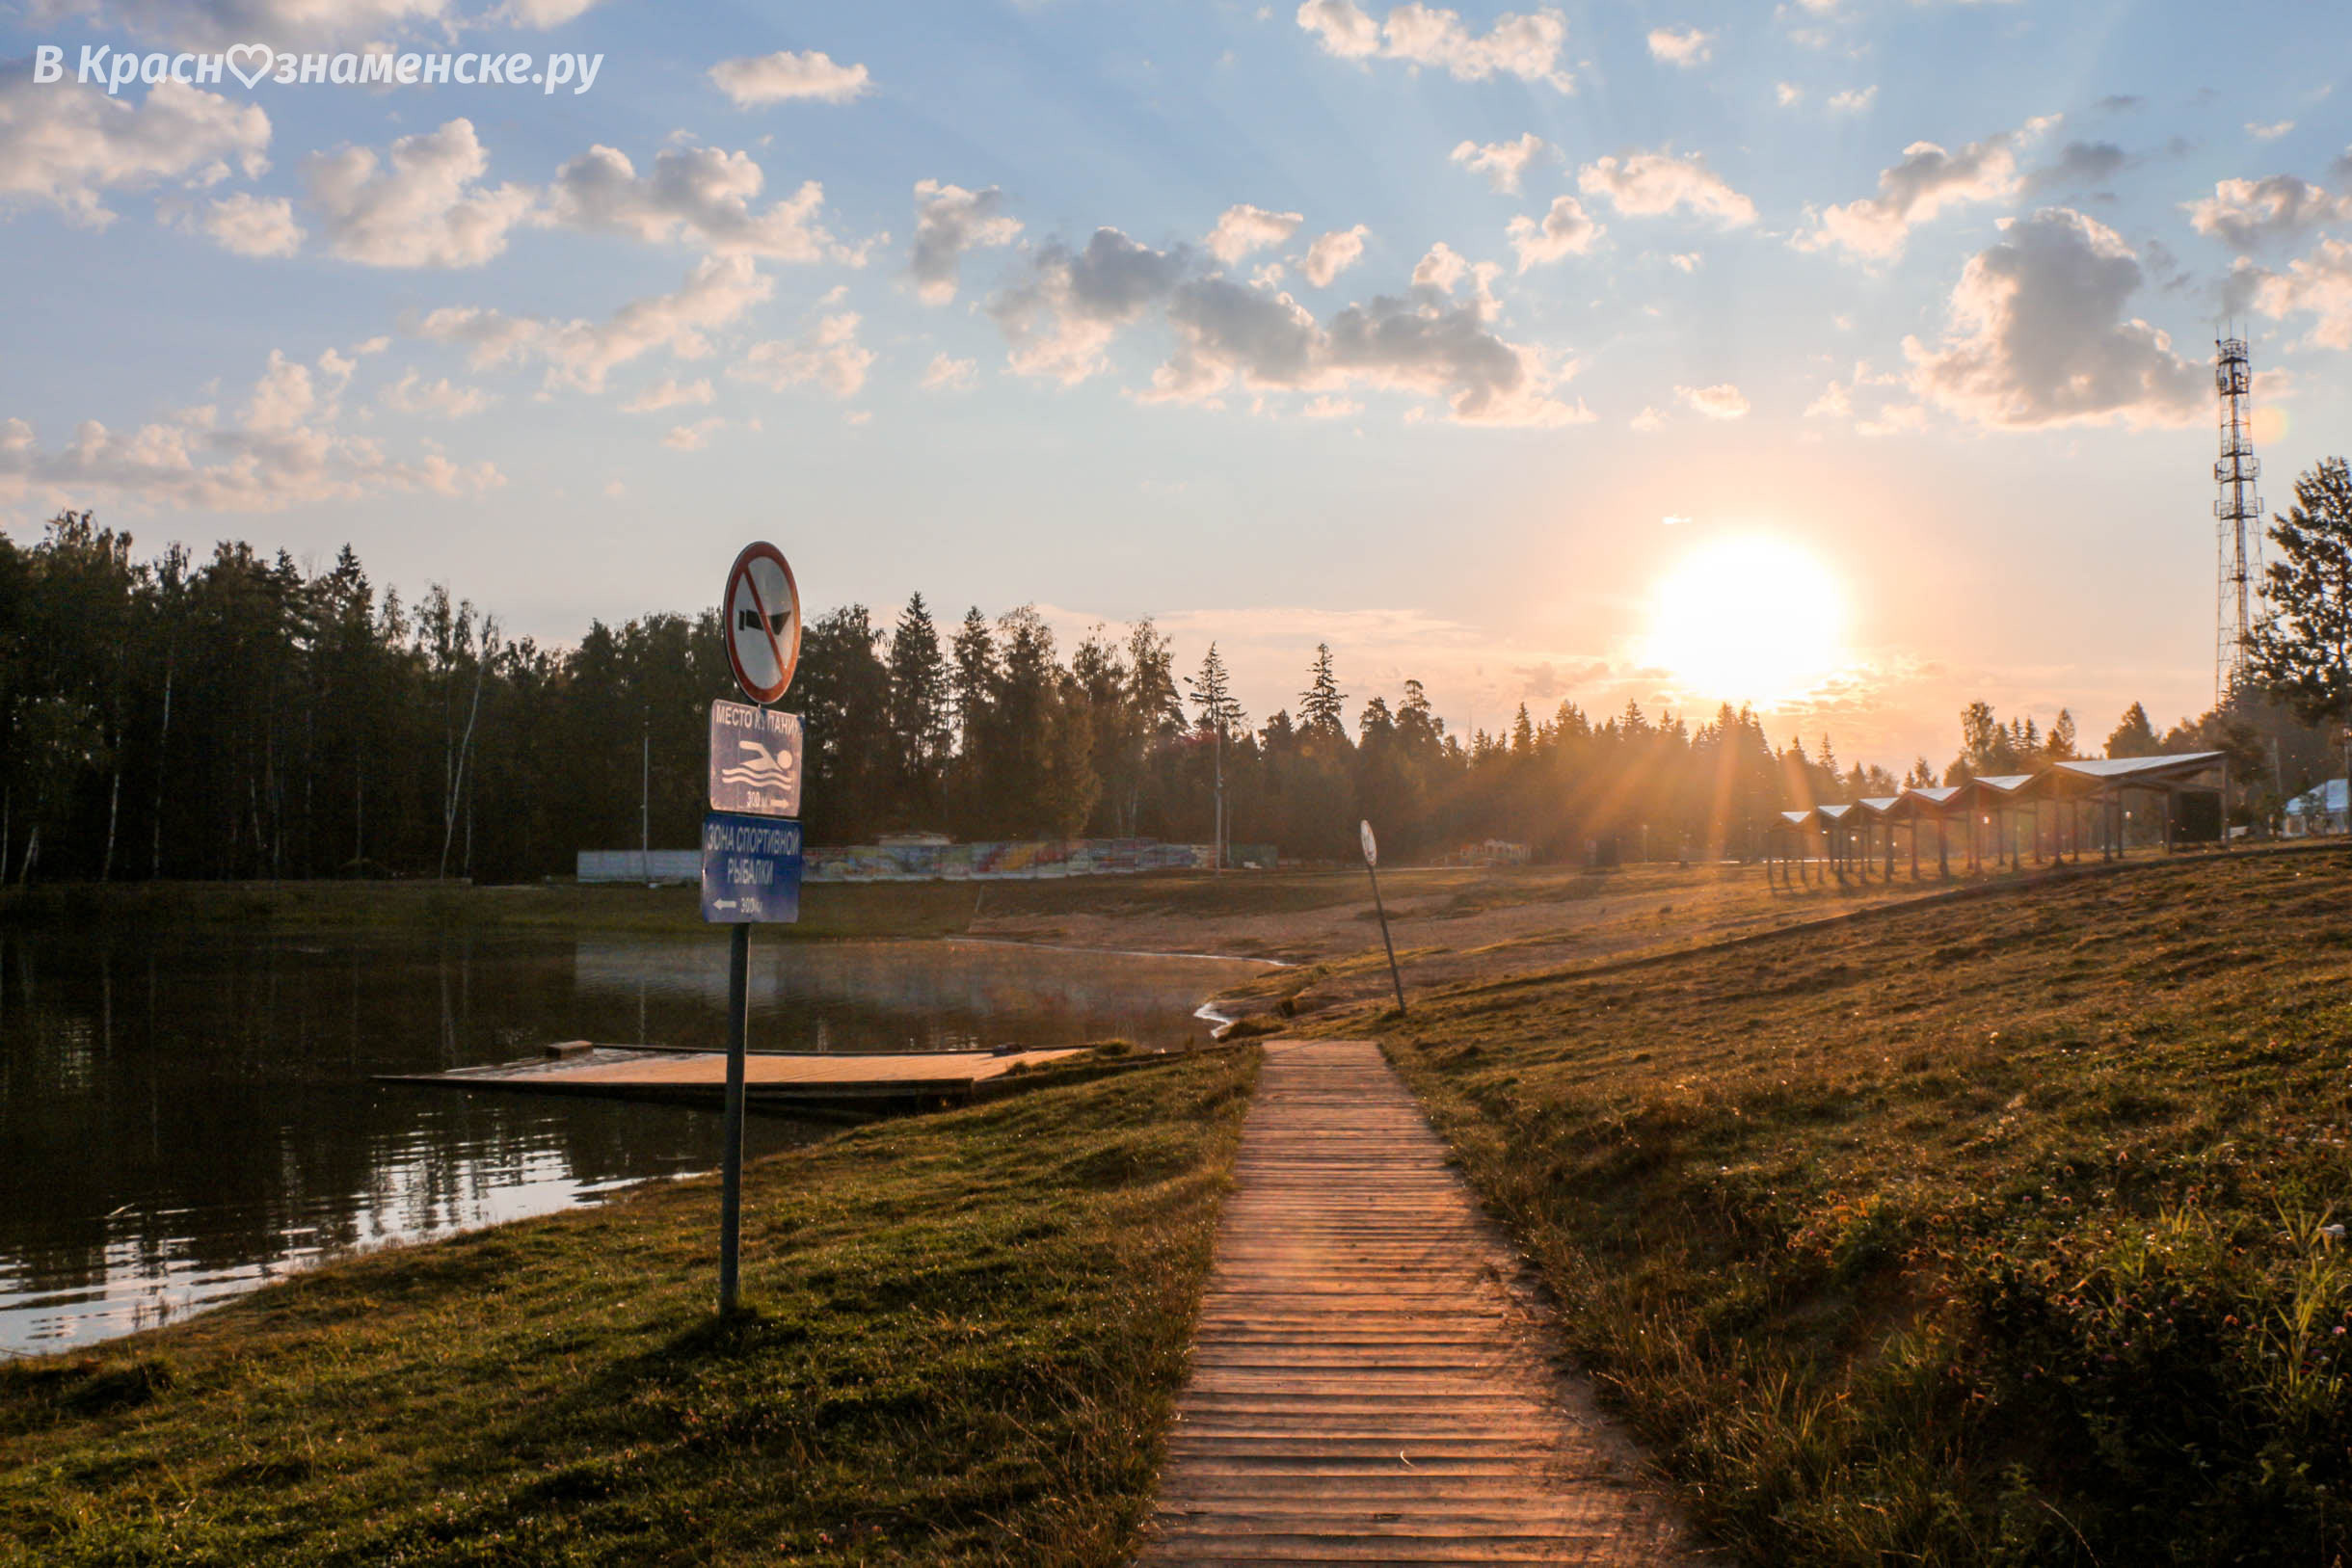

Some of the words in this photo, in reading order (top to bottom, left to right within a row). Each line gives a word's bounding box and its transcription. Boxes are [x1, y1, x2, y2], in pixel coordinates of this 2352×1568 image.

[716, 704, 752, 729] МЕСТО
[755, 711, 802, 736] КПАНИ
[708, 824, 735, 851] ЗОНА
[736, 826, 801, 856] СПОРТИВНОЙ
[728, 857, 774, 885] РЫБАЛКИ
